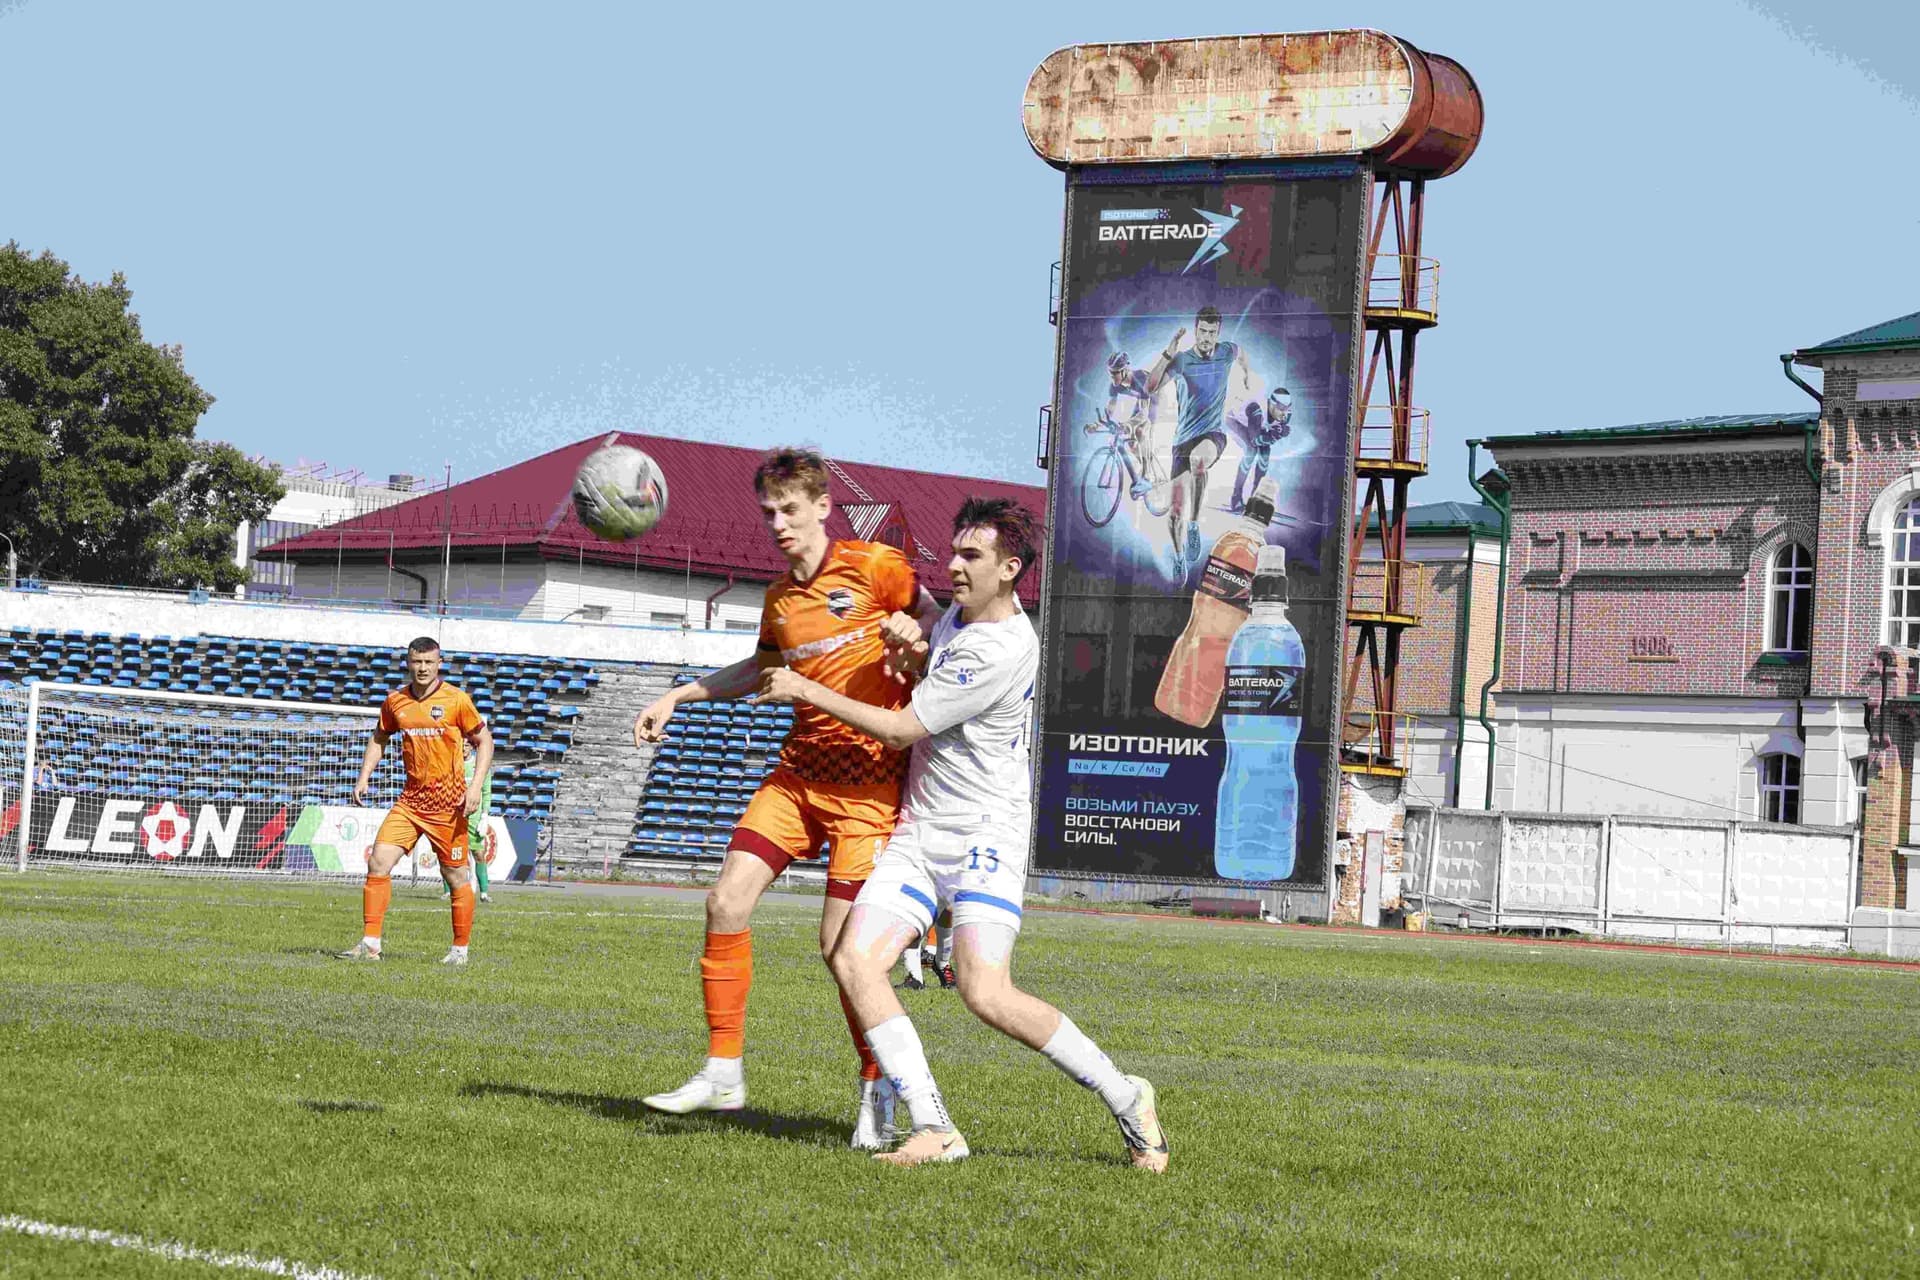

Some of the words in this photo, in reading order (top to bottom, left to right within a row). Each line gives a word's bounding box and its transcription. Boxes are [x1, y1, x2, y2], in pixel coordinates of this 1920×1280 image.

[1099, 223, 1222, 241] BATTERADE
[1228, 677, 1291, 688] BATTERADE
[1069, 734, 1209, 757] ИЗОТОНИК
[1065, 797, 1138, 813] ВОЗЬМИ
[1143, 801, 1201, 816] ПАУЗУ.
[45, 796, 246, 859] LEON
[1064, 814, 1181, 832] ВОССТАНОВИ
[1064, 830, 1118, 845] СИЛЫ.
[968, 846, 999, 873] 13
